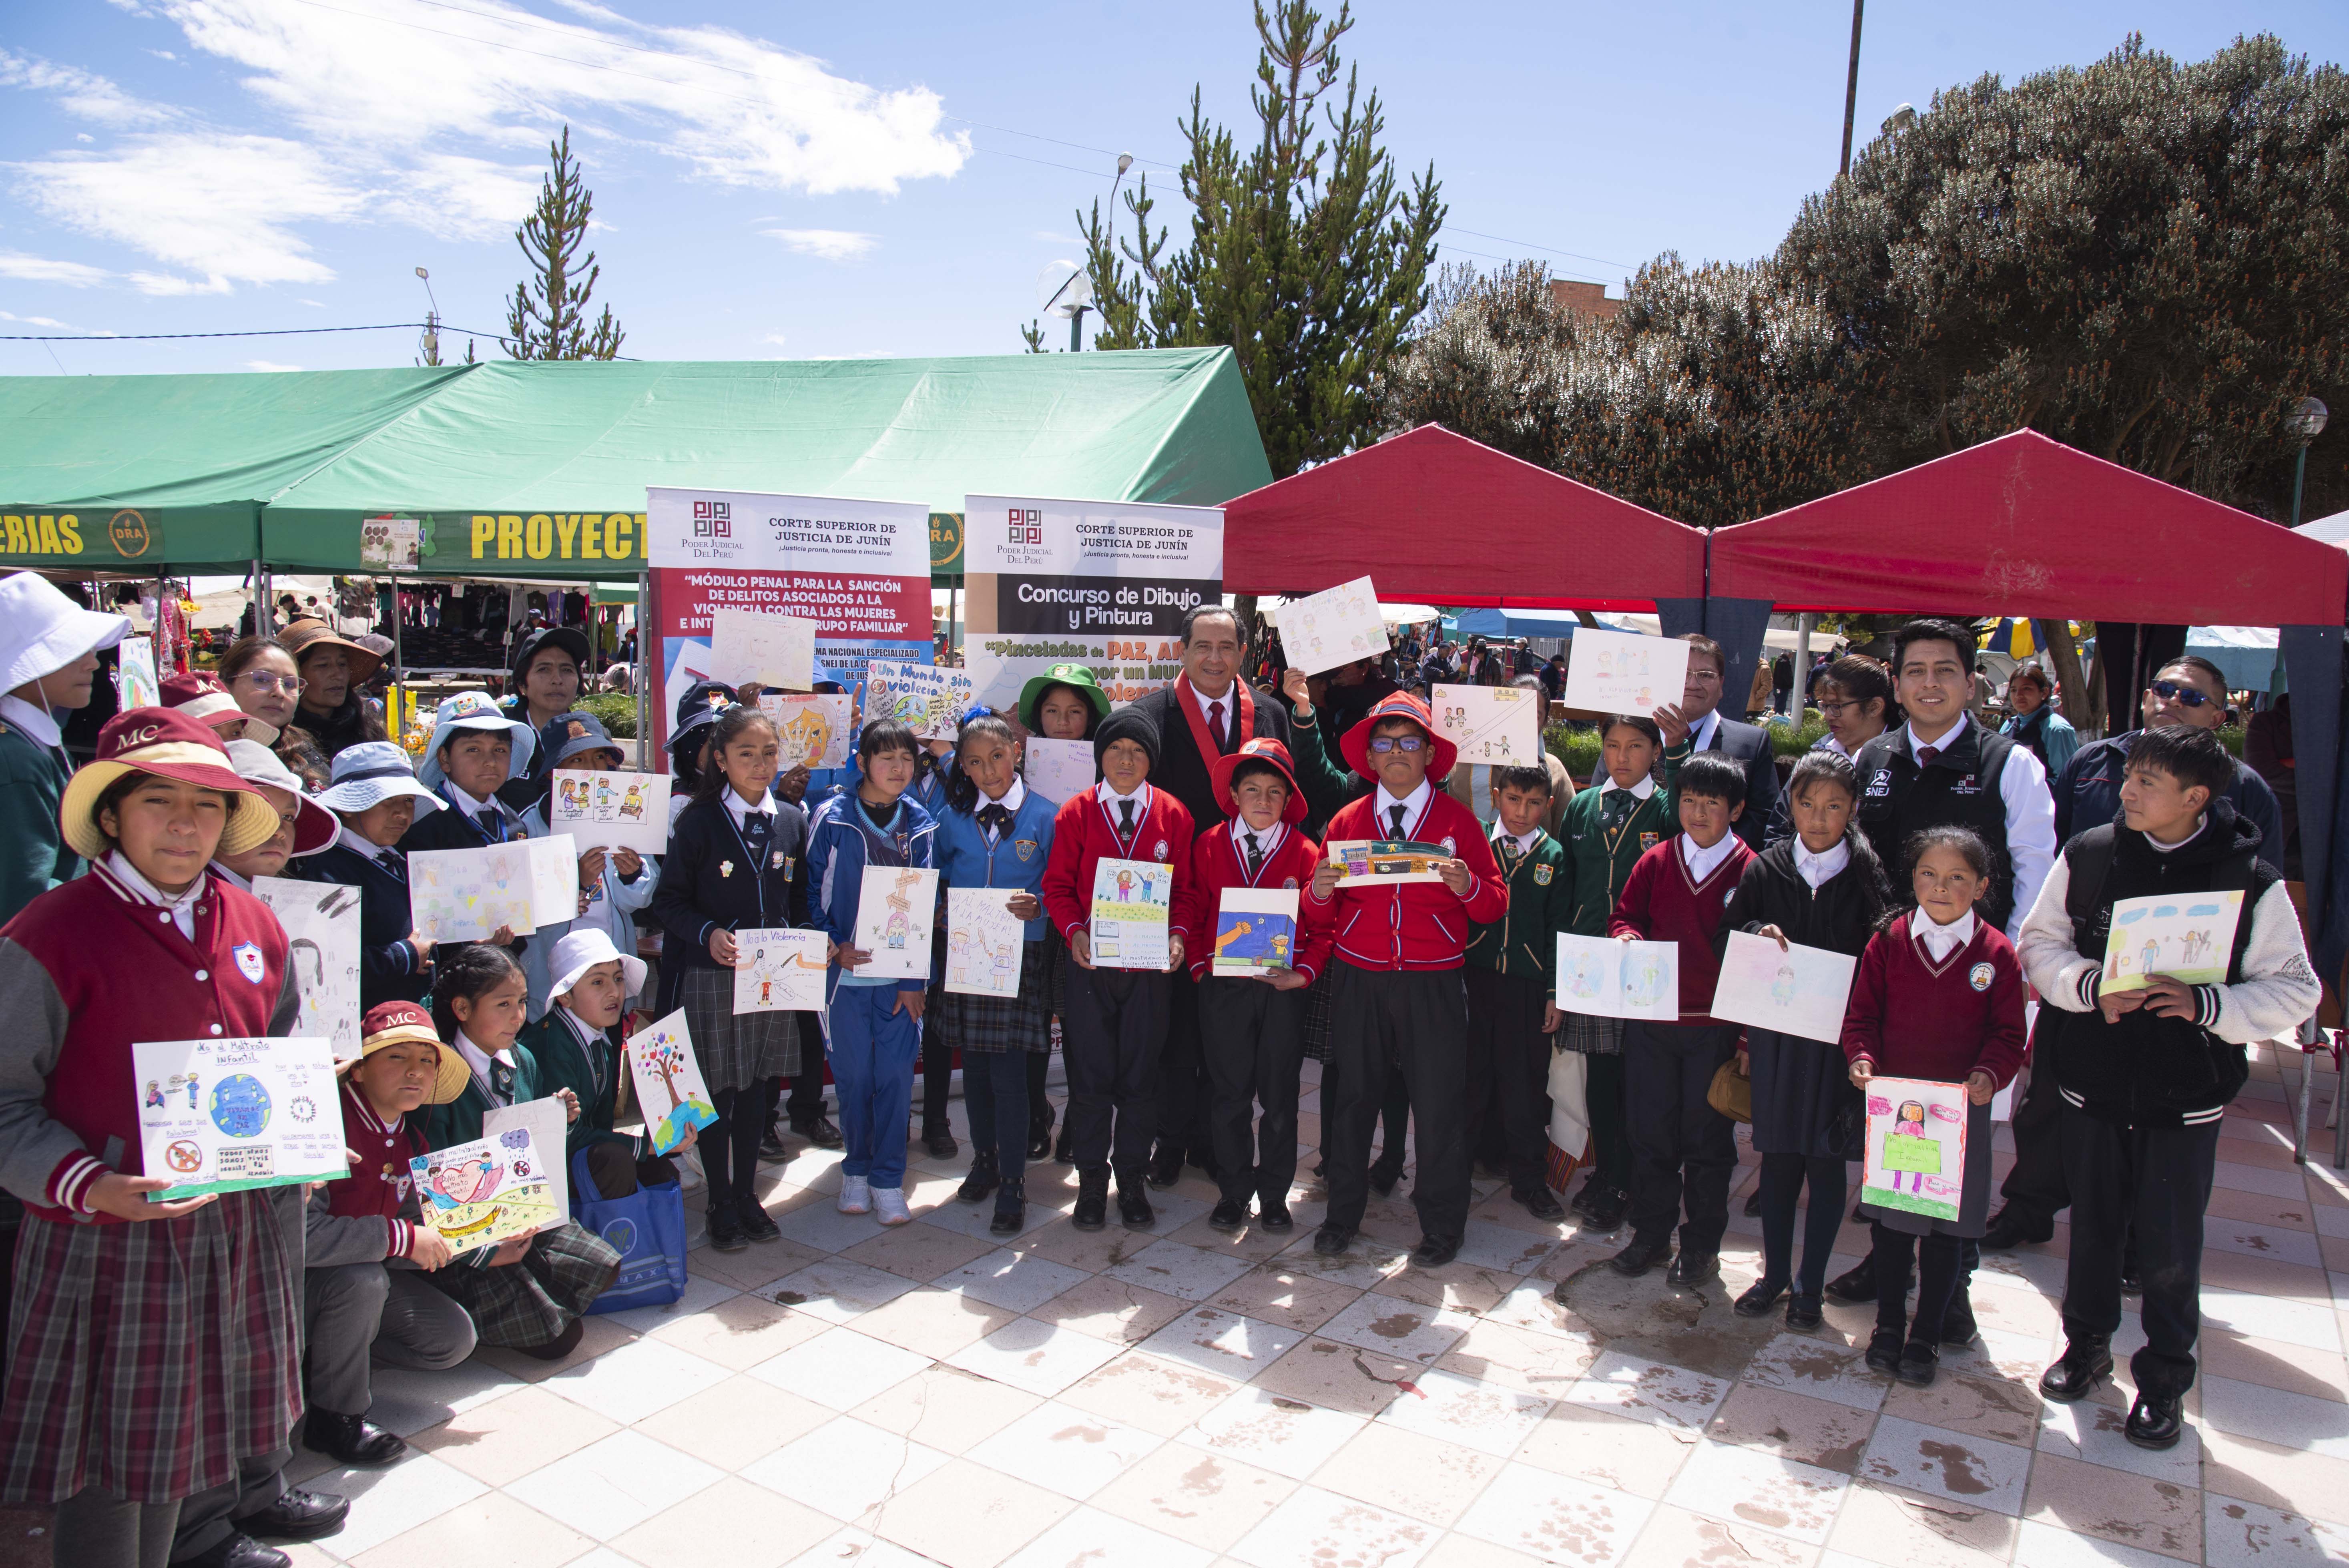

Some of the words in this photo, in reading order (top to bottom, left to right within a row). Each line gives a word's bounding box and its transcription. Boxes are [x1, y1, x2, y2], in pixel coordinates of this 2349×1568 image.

[769, 518, 811, 528] CORTE
[816, 520, 877, 532] SUPERIOR
[880, 524, 896, 533] DE
[1076, 524, 1115, 535] CORTE
[1118, 526, 1175, 537] SUPERIOR
[1178, 529, 1193, 537] DE
[115, 528, 143, 538] DRA
[775, 532, 832, 543] JUSTICIA
[836, 534, 853, 544] DE
[856, 534, 891, 546] JUNÍN
[930, 530, 955, 542] RA
[1081, 538, 1133, 548] JUSTICIA
[1136, 540, 1152, 549] DE
[1154, 539, 1188, 550] JUNÍN
[751, 577, 791, 588] PENAL
[793, 579, 825, 590] PARA
[828, 580, 843, 590] LA
[849, 579, 901, 592] SANCIÓN
[709, 589, 725, 600] DE
[727, 590, 779, 602] DELITOS
[782, 591, 854, 604] ASOCIADOS
[857, 594, 865, 604] A
[867, 594, 882, 605] LA
[1018, 583, 1110, 604] Concurso
[1116, 586, 1138, 605] de
[1144, 587, 1201, 611] Dibujo
[766, 605, 817, 617] CONTRA
[820, 607, 841, 618] LAS
[845, 608, 895, 619] MUJERES
[1069, 609, 1080, 629] y
[1086, 606, 1152, 625] Pintura
[681, 618, 688, 628] E
[815, 621, 847, 632] RUPO
[829, 648, 865, 657] NACIONAL
[867, 649, 919, 658] ESPECIALIZADO
[1091, 646, 1104, 657] de
[1107, 641, 1152, 664] PAZ,
[821, 659, 837, 668] SNEJ
[839, 660, 846, 668] DE
[850, 660, 858, 668] LA
[846, 672, 855, 680] DE
[877, 663, 895, 676] Un
[900, 664, 944, 683] Mundo
[951, 674, 972, 687] sin
[1123, 667, 1145, 680] un
[196, 679, 221, 693] MC
[116, 725, 158, 751] MC
[1865, 787, 1890, 796] SNEJ
[952, 904, 959, 913] A
[771, 930, 806, 942] Violencia
[385, 1012, 417, 1027] MC
